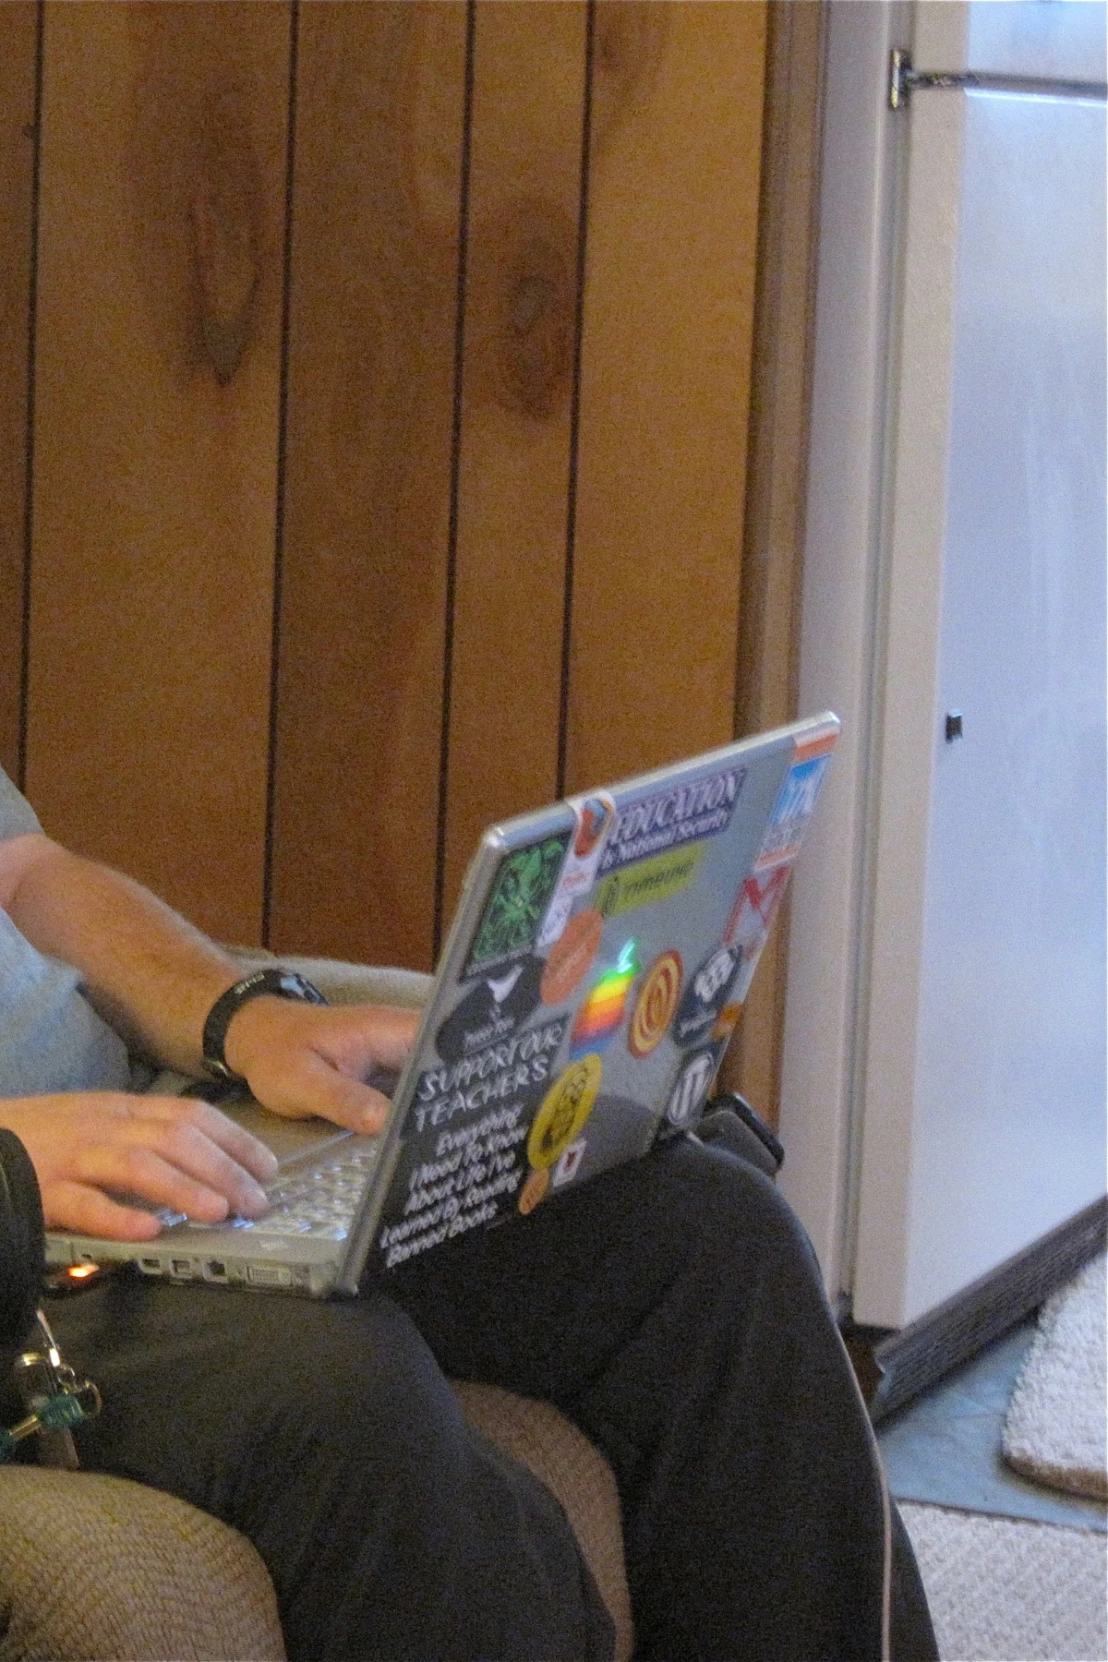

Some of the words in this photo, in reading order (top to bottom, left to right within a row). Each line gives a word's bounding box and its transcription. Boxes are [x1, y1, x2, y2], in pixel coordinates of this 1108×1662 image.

[609, 773, 736, 846] EDUCATION
[415, 1054, 548, 1132] TEACHERS
[418, 1036, 522, 1102] SUPPORT
[379, 1206, 443, 1249] Learned
